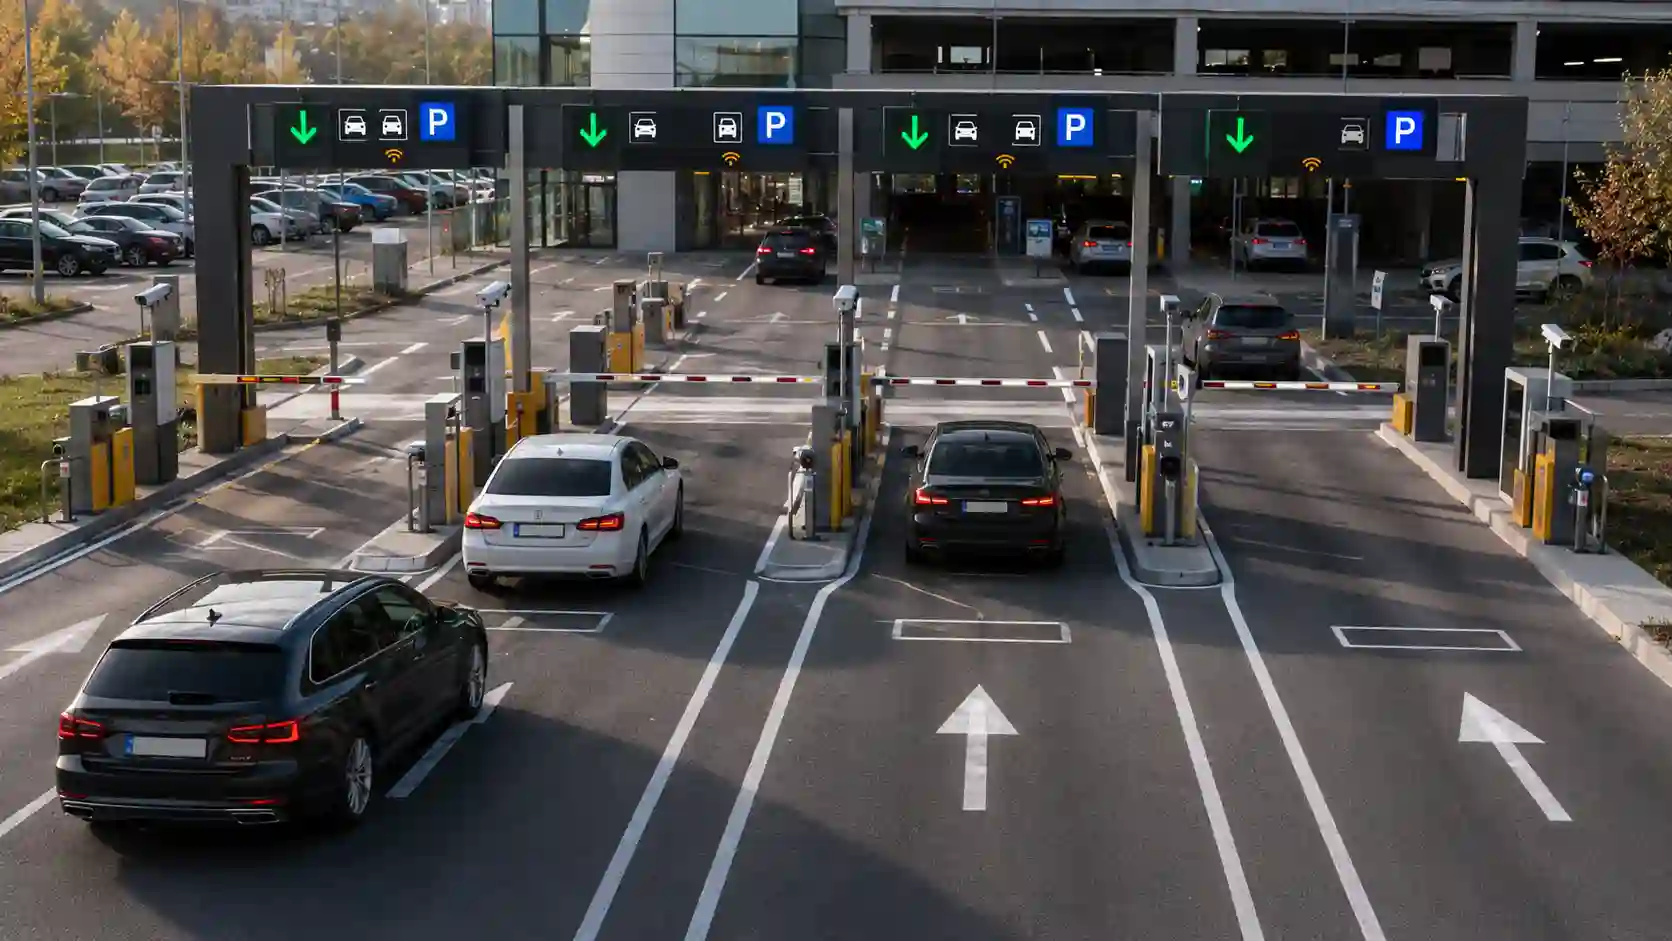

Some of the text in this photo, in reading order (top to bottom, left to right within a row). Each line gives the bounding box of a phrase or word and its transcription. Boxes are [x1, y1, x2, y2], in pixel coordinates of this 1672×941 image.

[429, 108, 448, 136] P
[766, 111, 786, 139] P
[1066, 113, 1086, 141] P
[1395, 116, 1416, 143] P
